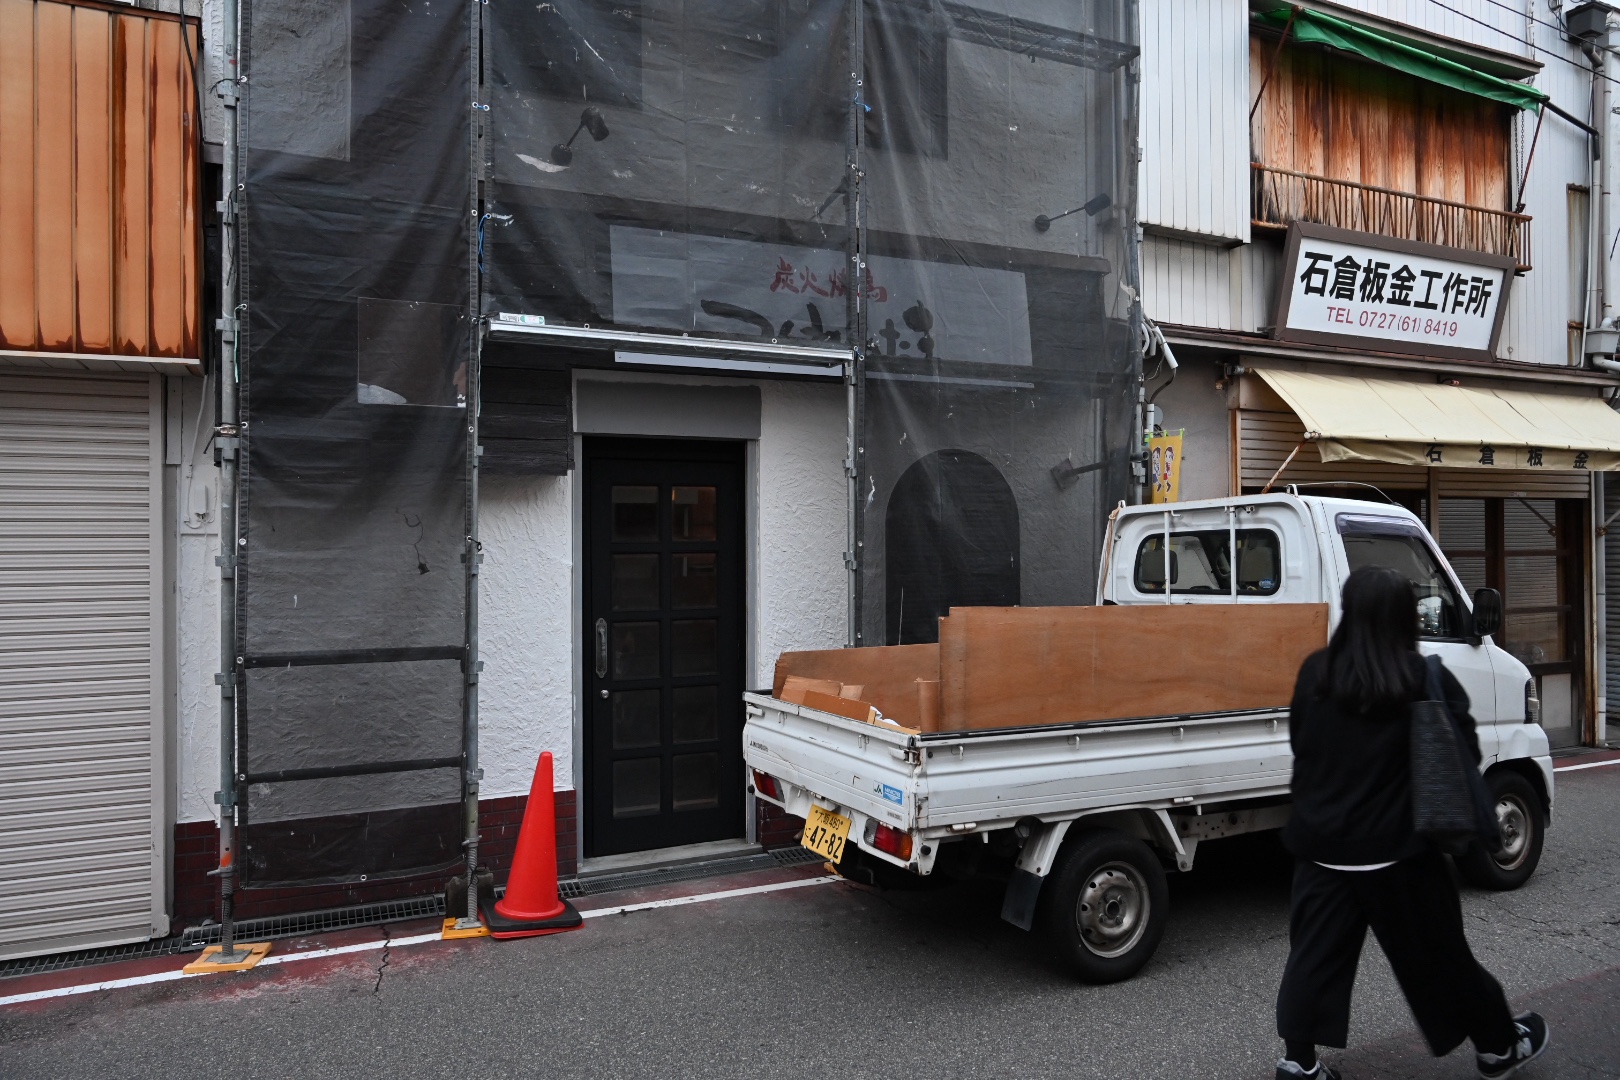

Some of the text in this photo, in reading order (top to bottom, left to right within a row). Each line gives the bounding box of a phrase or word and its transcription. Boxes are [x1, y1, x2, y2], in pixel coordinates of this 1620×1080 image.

[1300, 251, 1494, 318] 石倉板金工作所
[1327, 306, 1353, 325] TEL
